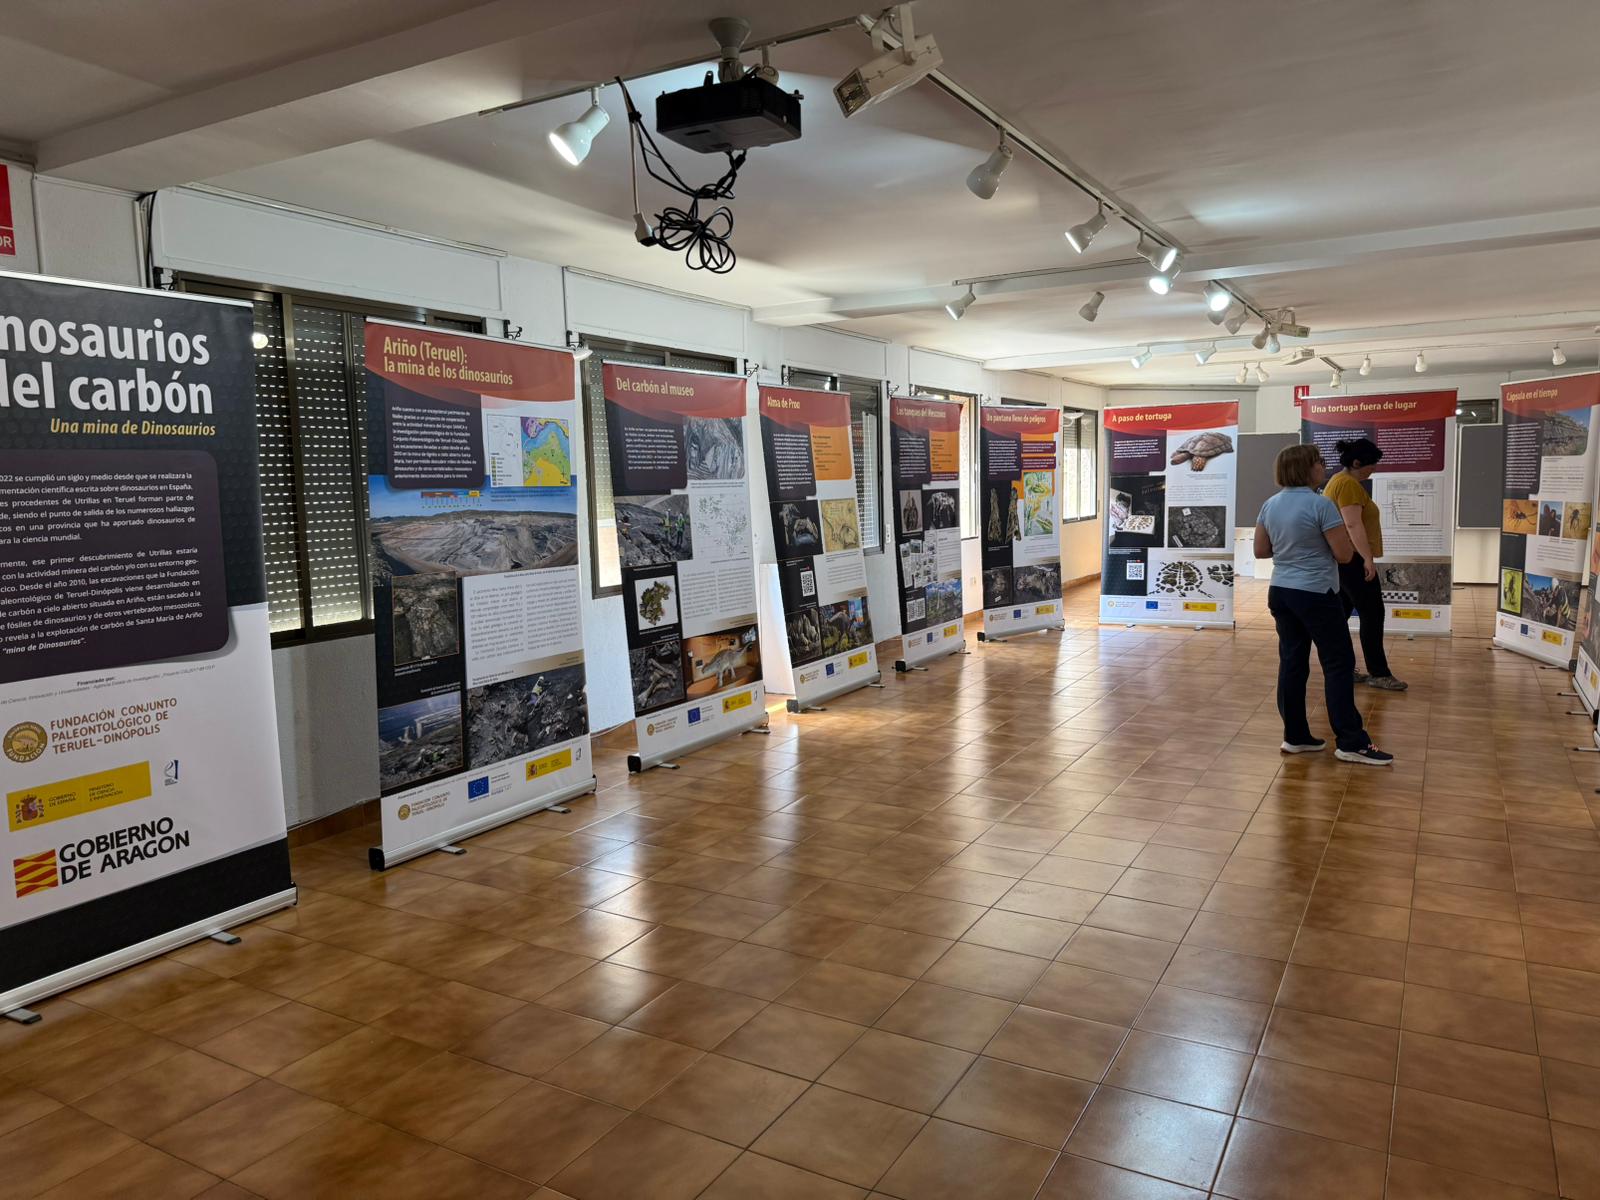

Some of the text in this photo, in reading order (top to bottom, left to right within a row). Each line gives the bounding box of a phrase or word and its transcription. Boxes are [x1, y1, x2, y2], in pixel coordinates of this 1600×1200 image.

[0, 236, 12, 247] R
[0, 315, 210, 365] nosaurios
[384, 335, 468, 364] Ariño (Teruel):
[384, 356, 513, 385] la mina de los dinosaurios
[69, 367, 213, 414] carbón
[616, 377, 694, 397] Del carbón al museo
[1311, 399, 1418, 415] Una tortuga fuera de lugar
[51, 418, 216, 436] Una mina de Dinosaurios
[1118, 415, 1134, 424] paso
[1135, 413, 1144, 421] de
[1145, 412, 1172, 422] tortuga
[24, 474, 55, 483] cumplió
[67, 473, 84, 482] siglo
[40, 485, 74, 494] científica
[99, 484, 119, 492] sobre
[119, 484, 159, 492] dinosaurios
[11, 498, 59, 508] procedentes
[114, 495, 136, 503] Teruel
[12, 511, 38, 519] siendo
[48, 510, 71, 519] punto
[82, 508, 104, 516] salida
[165, 505, 195, 513] hallazgos
[47, 521, 81, 531] provincia
[83, 521, 98, 529] que
[112, 518, 144, 527] aportado
[146, 516, 185, 524] dinosaurios
[21, 535, 48, 543] ciencia
[49, 556, 75, 566] primer
[78, 552, 133, 562] descubrimiento
[148, 549, 172, 557] Utrillas
[19, 582, 44, 591] Desde
[52, 580, 67, 588] año
[100, 574, 145, 583] excavaciones
[166, 568, 200, 577] Fundación
[25, 568, 60, 578] actividad
[60, 567, 87, 575] minera
[87, 565, 99, 573] del
[99, 563, 124, 572] carbón
[54, 592, 64, 600] de
[66, 586, 123, 598] Teruel-Dinópolis
[144, 580, 190, 590] desarrollando
[7, 607, 35, 616] carbón
[42, 604, 60, 613] cielo
[61, 602, 88, 611] abierto
[88, 599, 115, 608] situada
[6, 620, 32, 629] fósiles
[43, 614, 87, 625] dinosaurios
[103, 610, 122, 618] otros
[122, 605, 163, 615] vertebrados
[37, 630, 44, 638] la
[45, 625, 88, 637] explotación
[99, 621, 124, 630] carbón
[155, 614, 174, 622] María
[184, 611, 203, 619] Ariño
[26, 643, 37, 651] de
[50, 697, 178, 730] FUNDACIÓN CONJUNTO
[52, 713, 151, 743] PALEONTOLÓGICO
[156, 711, 169, 722] DE
[59, 816, 174, 863] GOBIERNO
[61, 830, 190, 885] DE ARAGON
